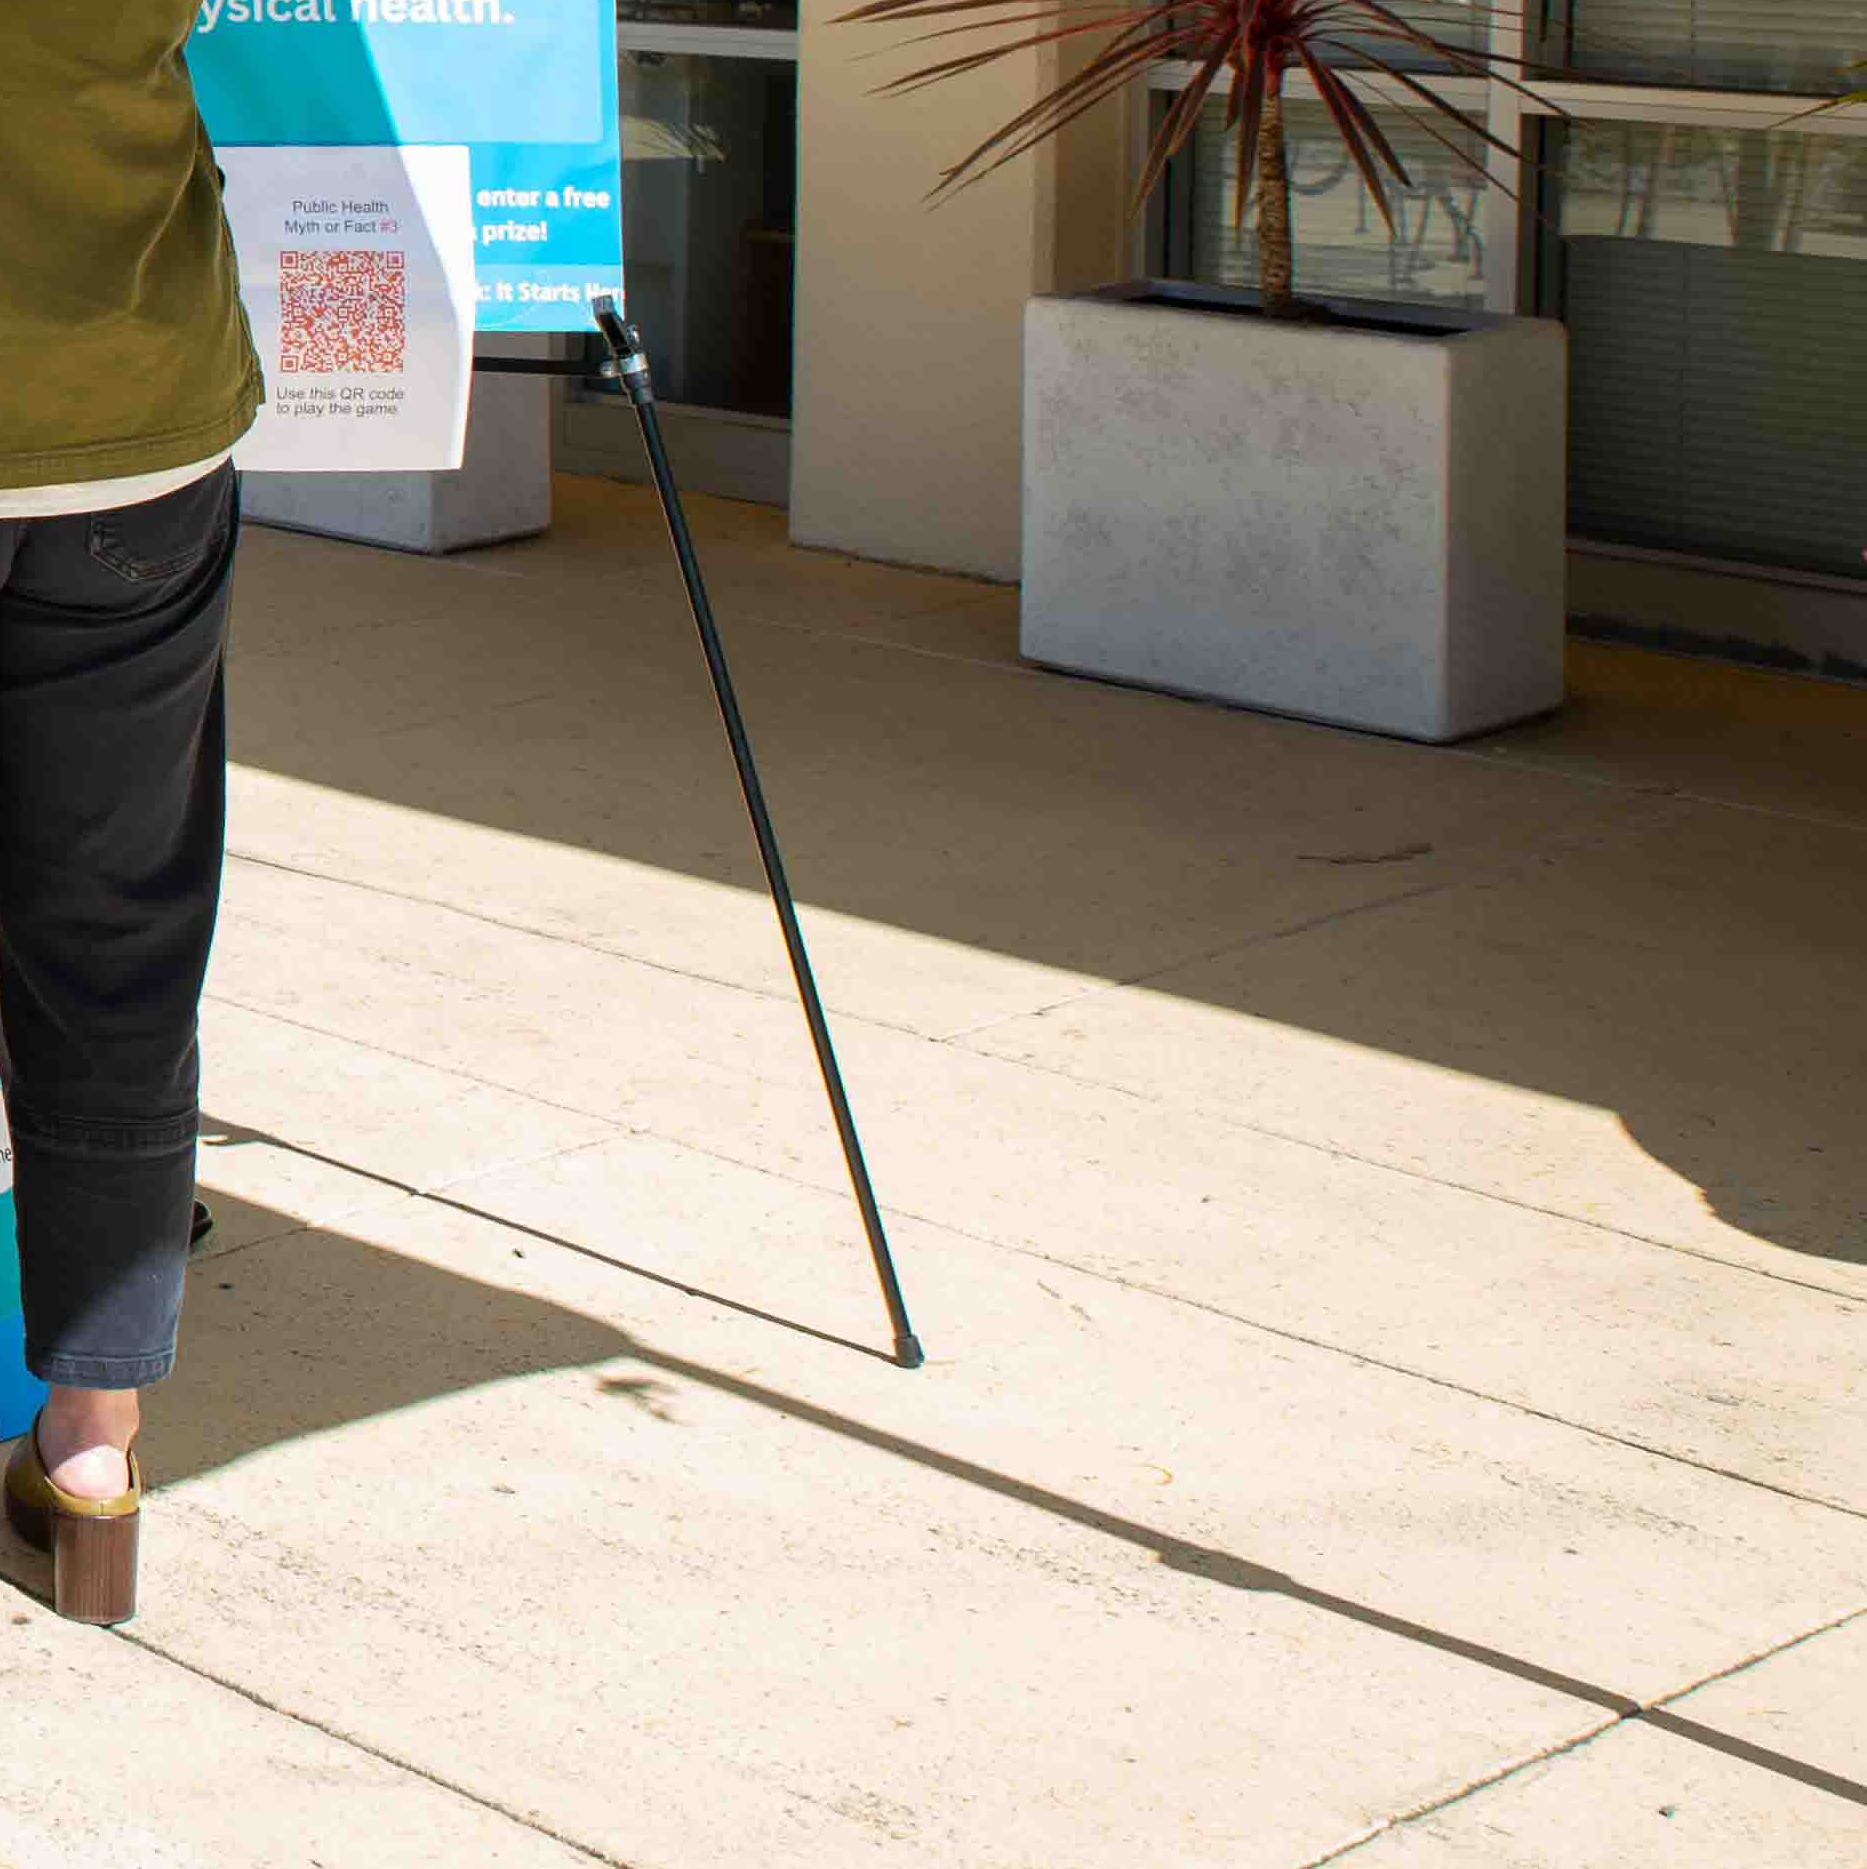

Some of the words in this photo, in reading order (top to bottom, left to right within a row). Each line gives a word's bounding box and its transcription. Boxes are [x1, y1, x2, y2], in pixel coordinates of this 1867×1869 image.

[476, 190, 541, 207] enter
[545, 190, 559, 208] a
[563, 185, 610, 208] free
[292, 200, 338, 214] Public
[342, 200, 389, 214] Health
[284, 220, 320, 235] Myth
[325, 222, 339, 233] or
[344, 220, 376, 233] Fact
[380, 219, 398, 232] #3
[482, 219, 547, 246] prize!
[496, 283, 512, 301] It
[519, 282, 580, 303] Starts
[276, 387, 305, 400] Use
[310, 387, 335, 400] this
[339, 387, 364, 400] QR
[369, 387, 404, 400] code
[276, 403, 289, 415] to
[294, 403, 324, 417] play
[329, 403, 351, 414] the
